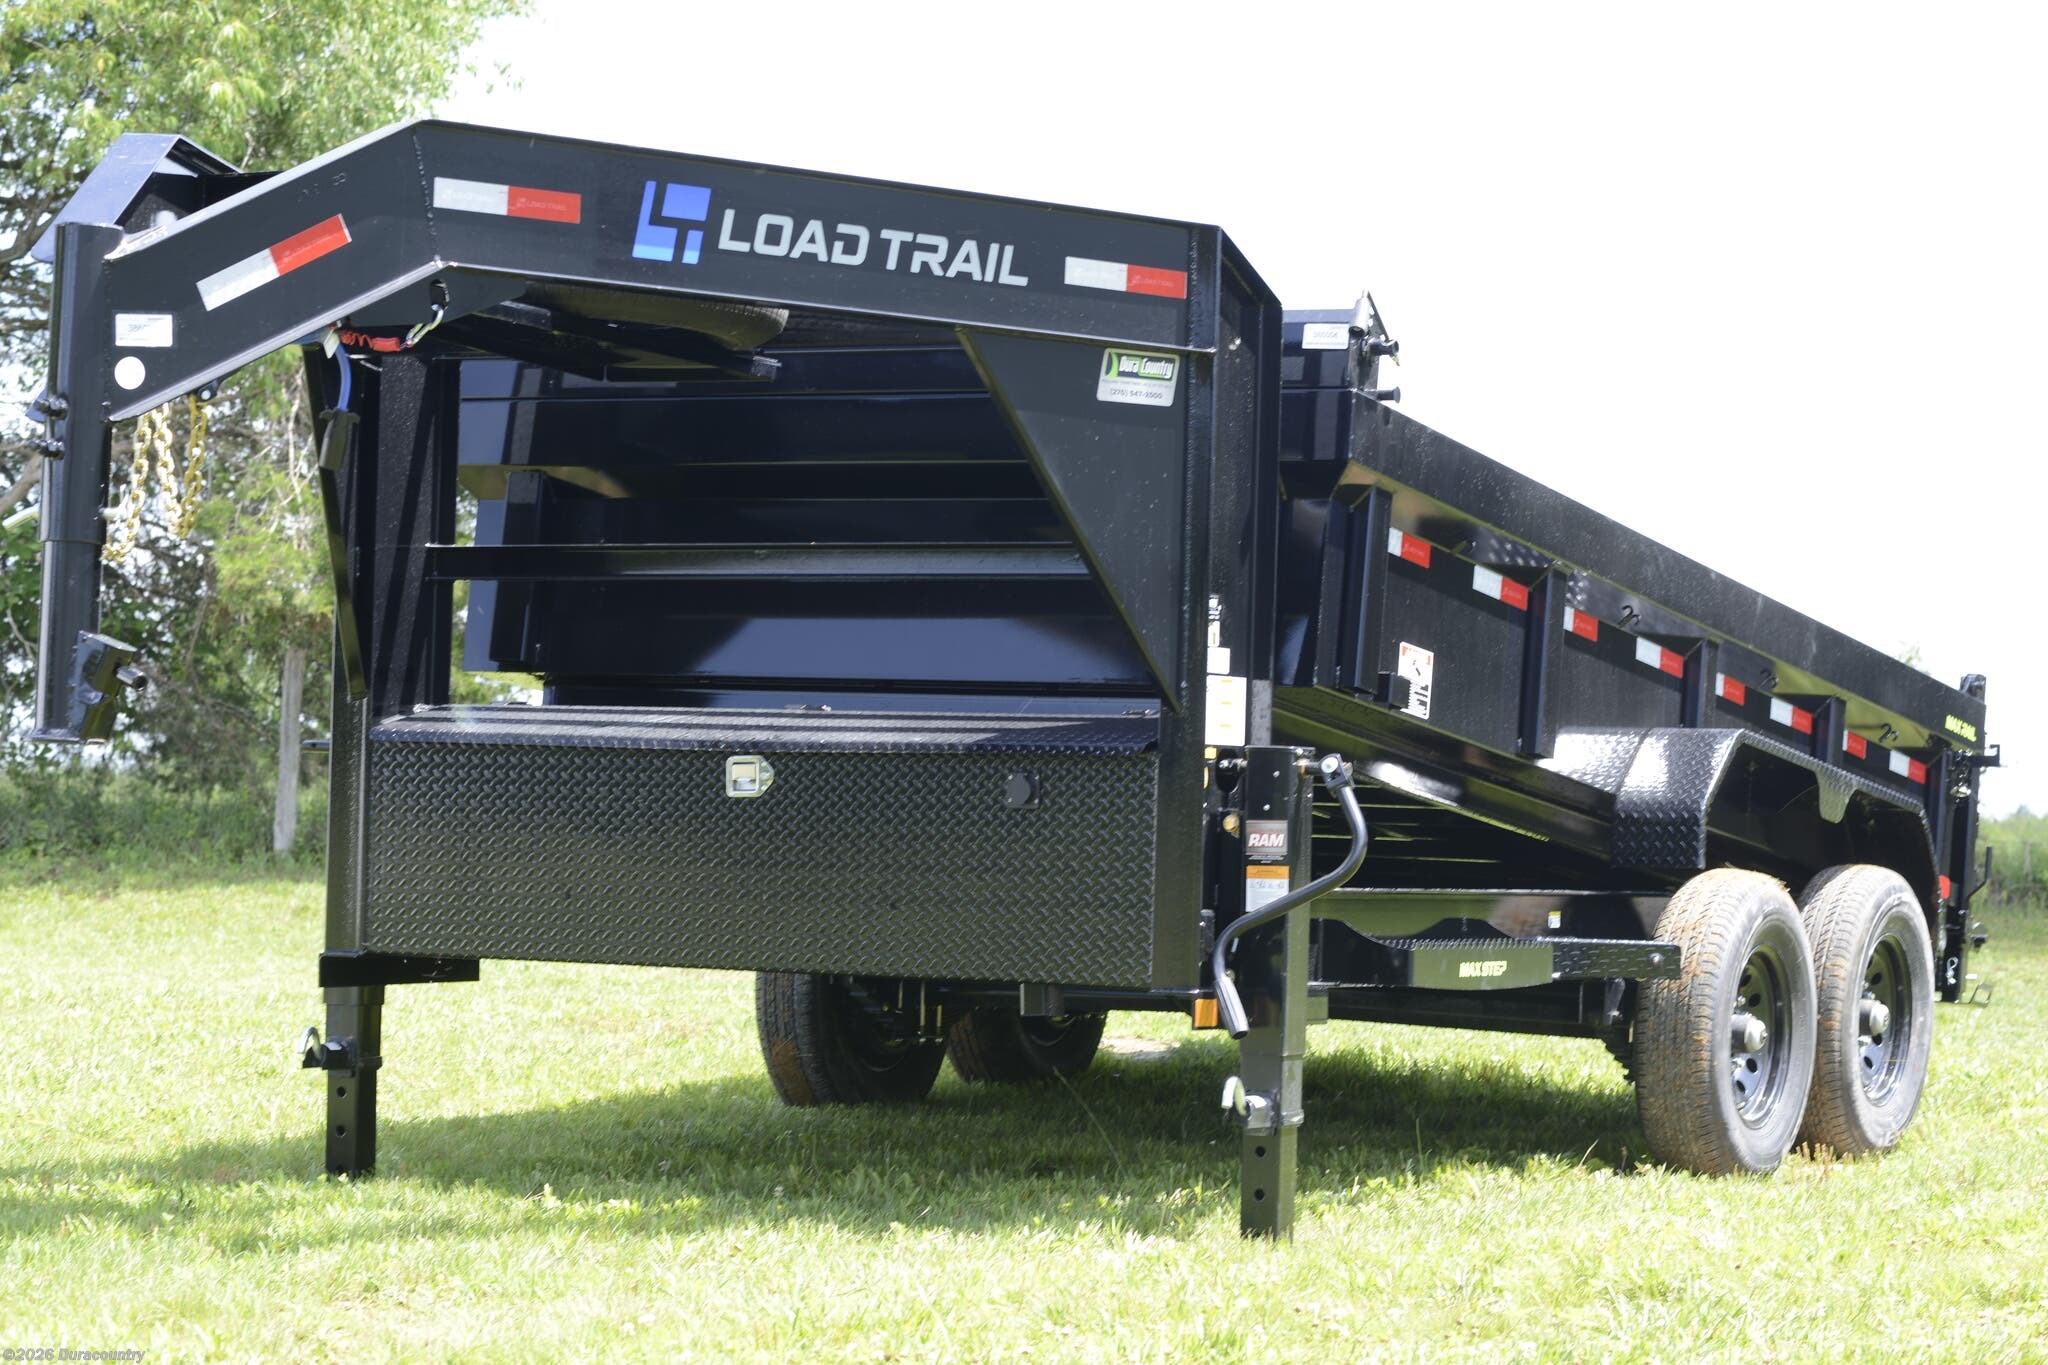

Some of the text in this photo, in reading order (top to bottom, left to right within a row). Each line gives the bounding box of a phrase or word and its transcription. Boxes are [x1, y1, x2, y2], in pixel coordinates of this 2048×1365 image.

[718, 208, 870, 266] LOAD
[880, 228, 1029, 287] TRAIL
[1119, 355, 1174, 379] Dura Country
[1248, 832, 1285, 848] RAM
[1459, 960, 1508, 977] MAX STEP
